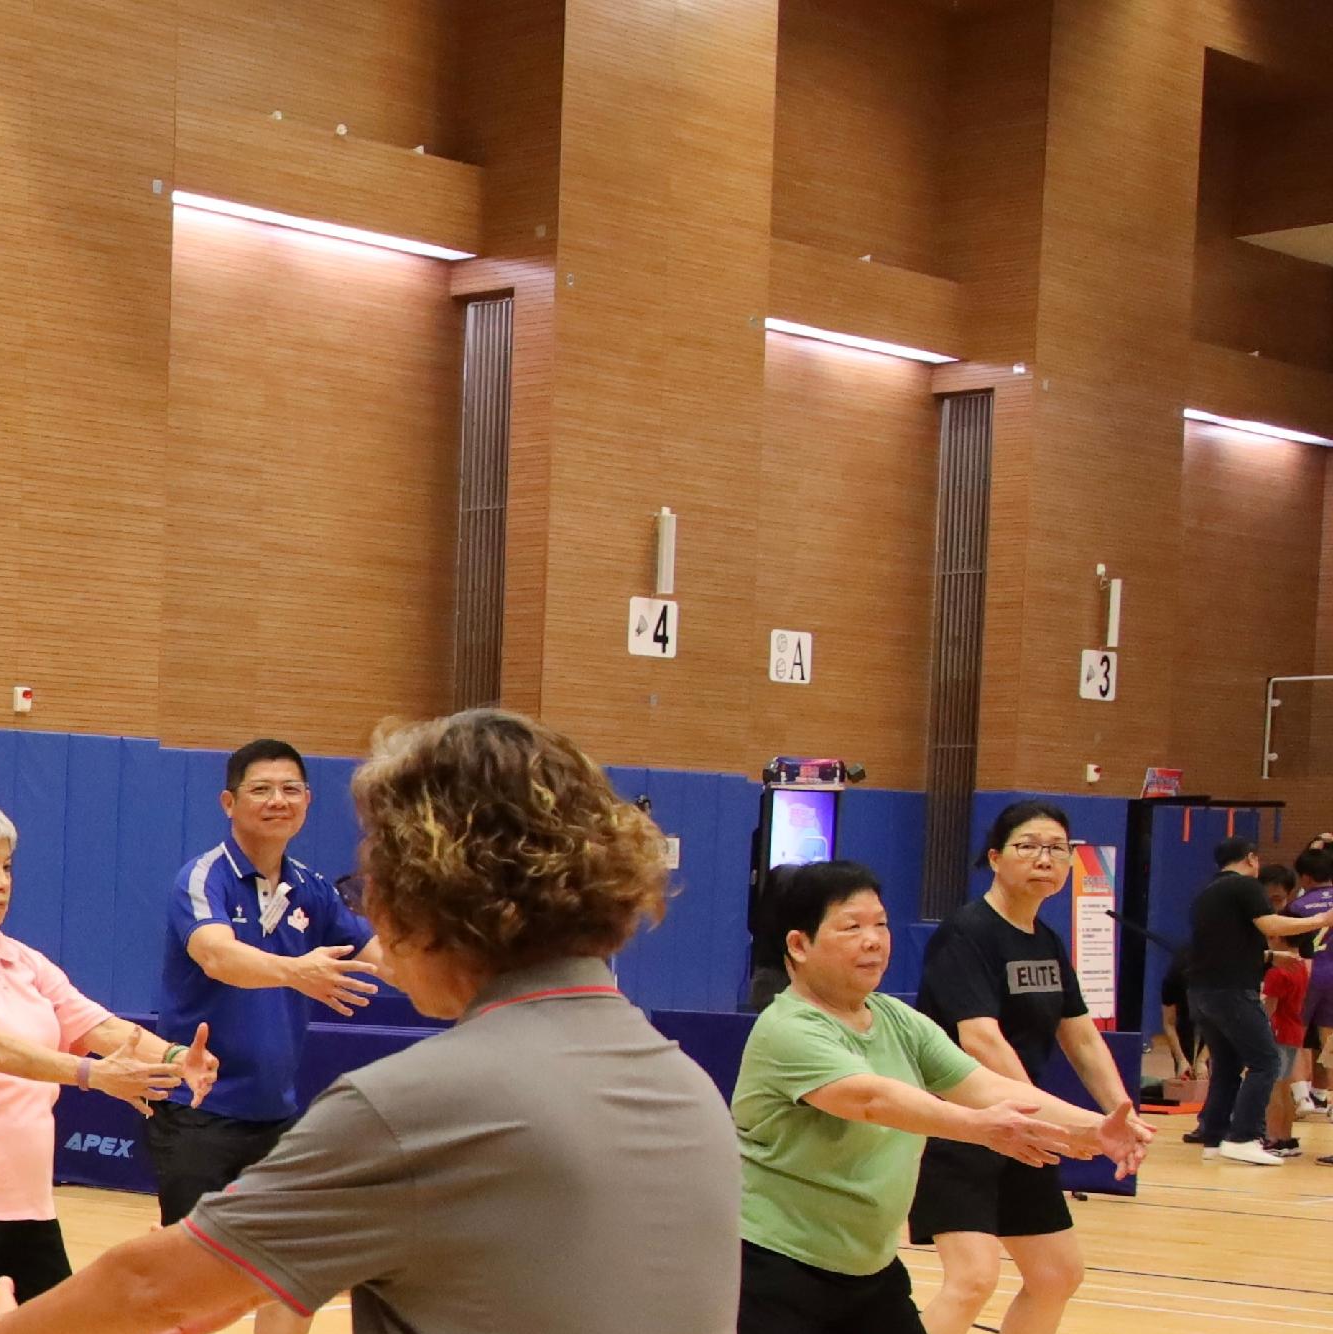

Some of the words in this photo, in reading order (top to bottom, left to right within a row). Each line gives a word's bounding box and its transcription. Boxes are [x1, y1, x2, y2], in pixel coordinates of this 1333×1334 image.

[652, 604, 669, 654] 4
[789, 636, 805, 681] A
[1099, 655, 1110, 698] 3
[1017, 966, 1059, 987] ELITE
[64, 1132, 135, 1158] APEX
